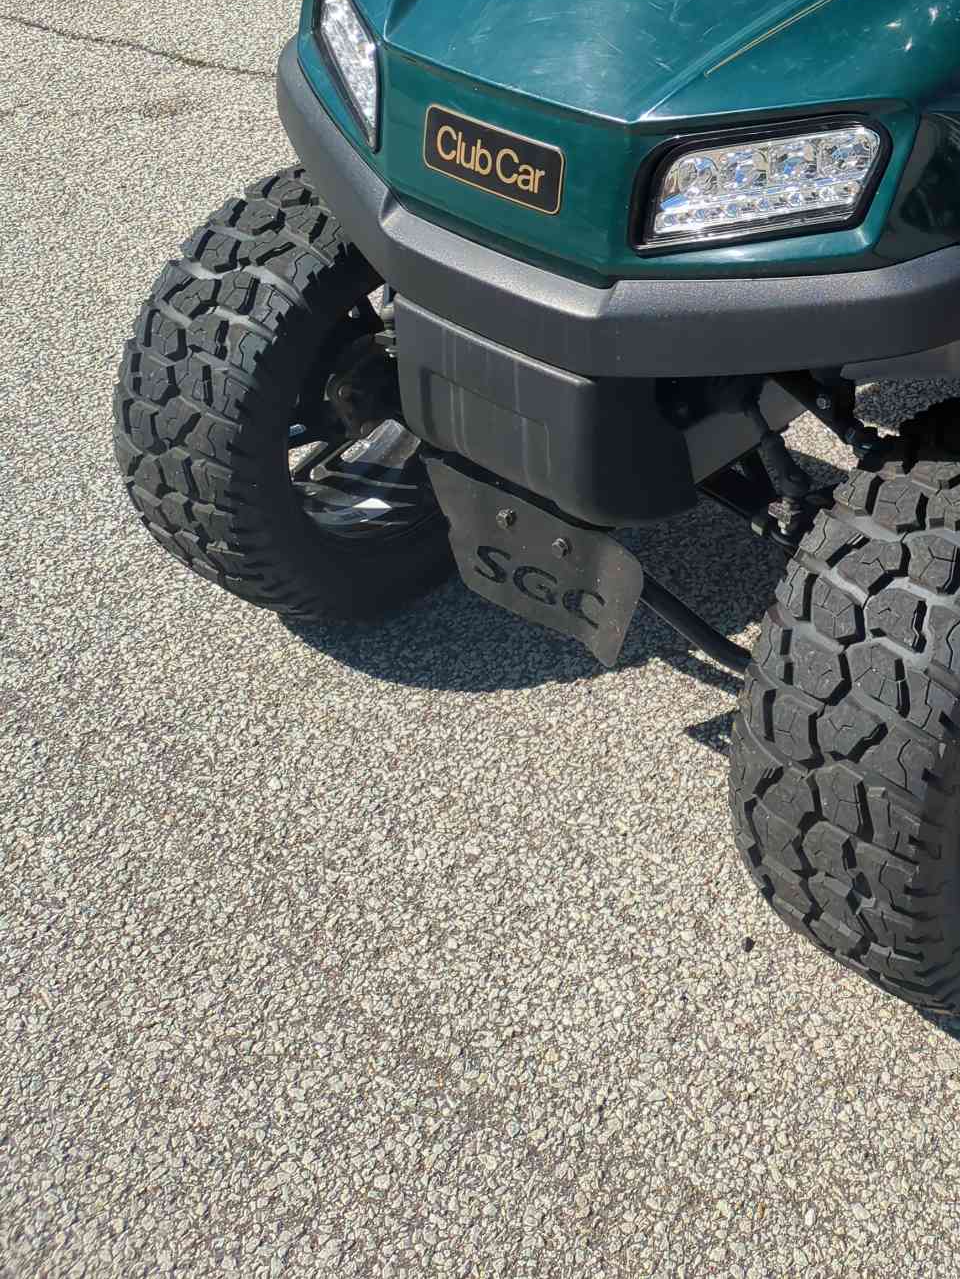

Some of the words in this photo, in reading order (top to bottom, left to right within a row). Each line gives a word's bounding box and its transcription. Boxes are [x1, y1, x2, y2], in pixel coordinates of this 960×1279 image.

[436, 125, 493, 176] Club
[495, 148, 546, 194] Car
[473, 545, 606, 629] SGC
